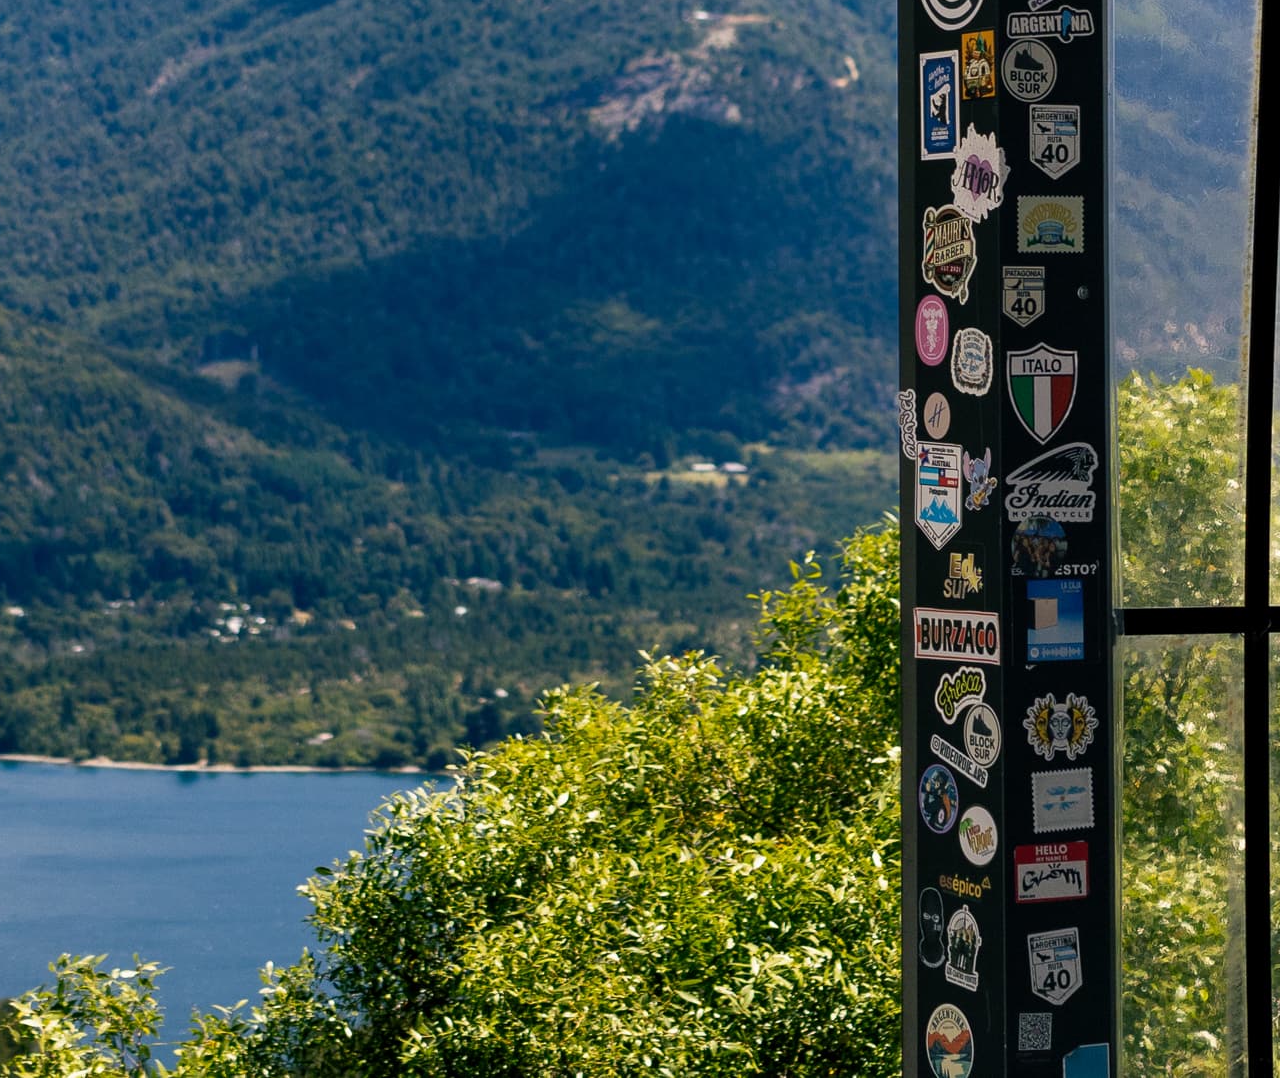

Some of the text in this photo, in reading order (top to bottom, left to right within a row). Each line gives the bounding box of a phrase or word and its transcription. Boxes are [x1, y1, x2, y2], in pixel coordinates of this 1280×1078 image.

[1010, 70, 1049, 83] BLOCK
[1017, 83, 1041, 94] SUR
[1041, 144, 1069, 163] 40
[934, 217, 971, 249] MAURI'S
[934, 243, 965, 264] BARBER
[1011, 297, 1037, 316] 40
[1022, 359, 1062, 373] ITALO
[1009, 483, 1093, 509] Indian
[1012, 510, 1090, 518] MOTORCYCLE
[949, 552, 975, 579] Ed
[920, 617, 997, 655] BURZACO
[969, 735, 996, 750] BLOCK
[974, 748, 991, 760] SUR
[1035, 844, 1069, 856] HELLO
[1047, 962, 1063, 970] RUTA
[1043, 969, 1071, 991] 40
[931, 1008, 964, 1030] ARGENTINA
